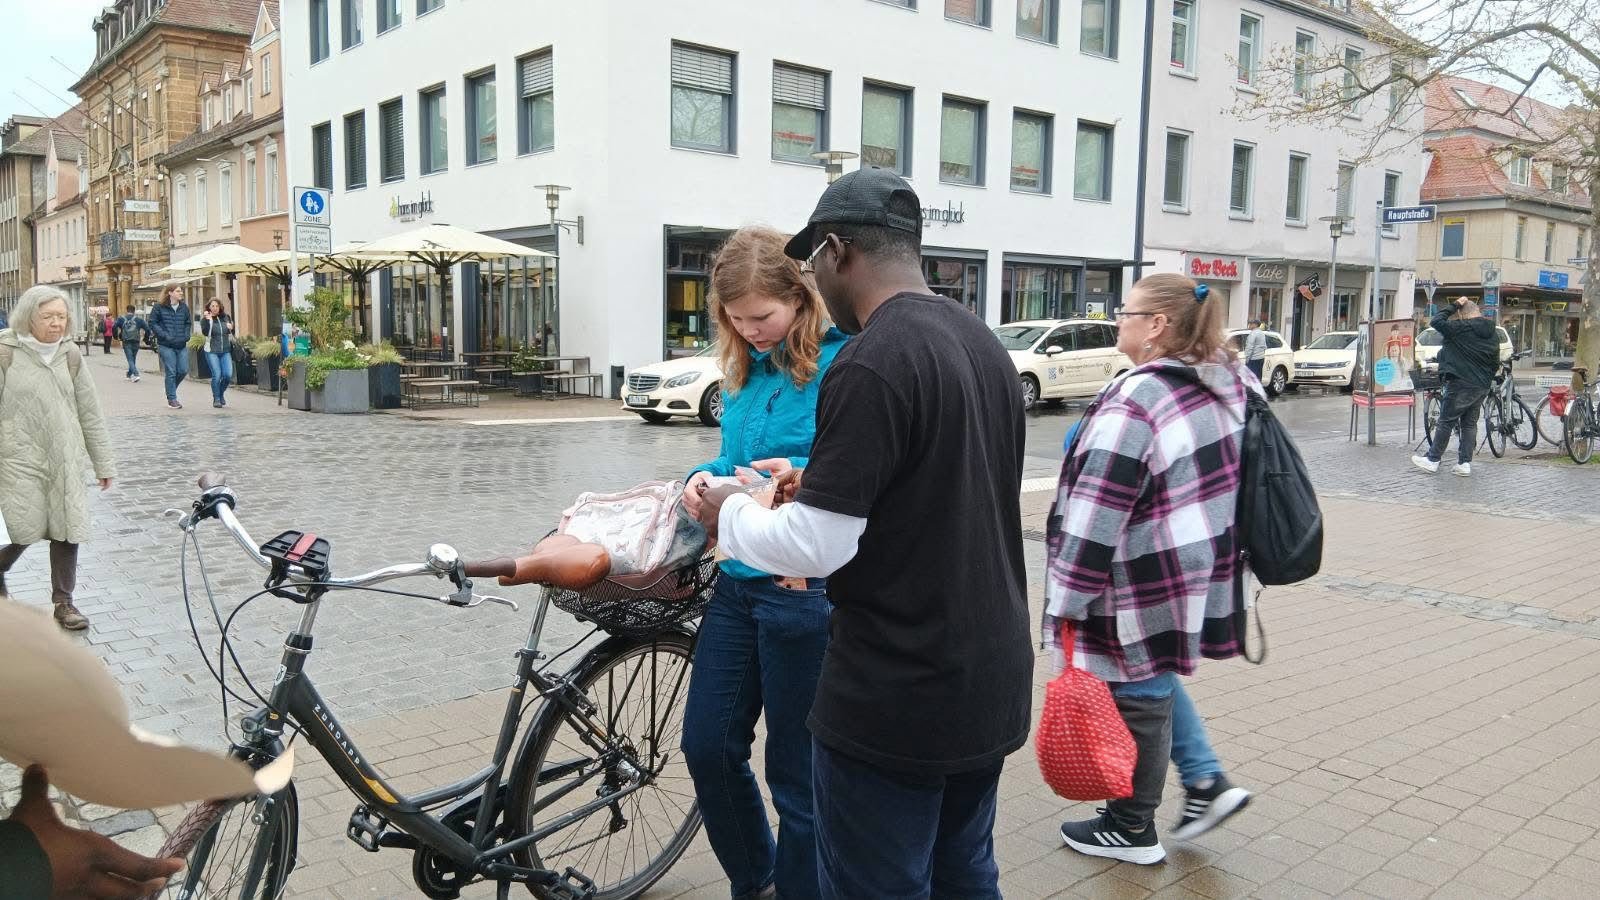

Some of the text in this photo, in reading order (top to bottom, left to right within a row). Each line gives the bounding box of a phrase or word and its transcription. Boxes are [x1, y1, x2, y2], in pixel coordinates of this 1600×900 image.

[303, 215, 322, 223] ZONE
[928, 204, 941, 221] im
[942, 199, 965, 227] glück
[1388, 209, 1430, 220] Hauptstraße
[1191, 257, 1238, 278] Der Beck
